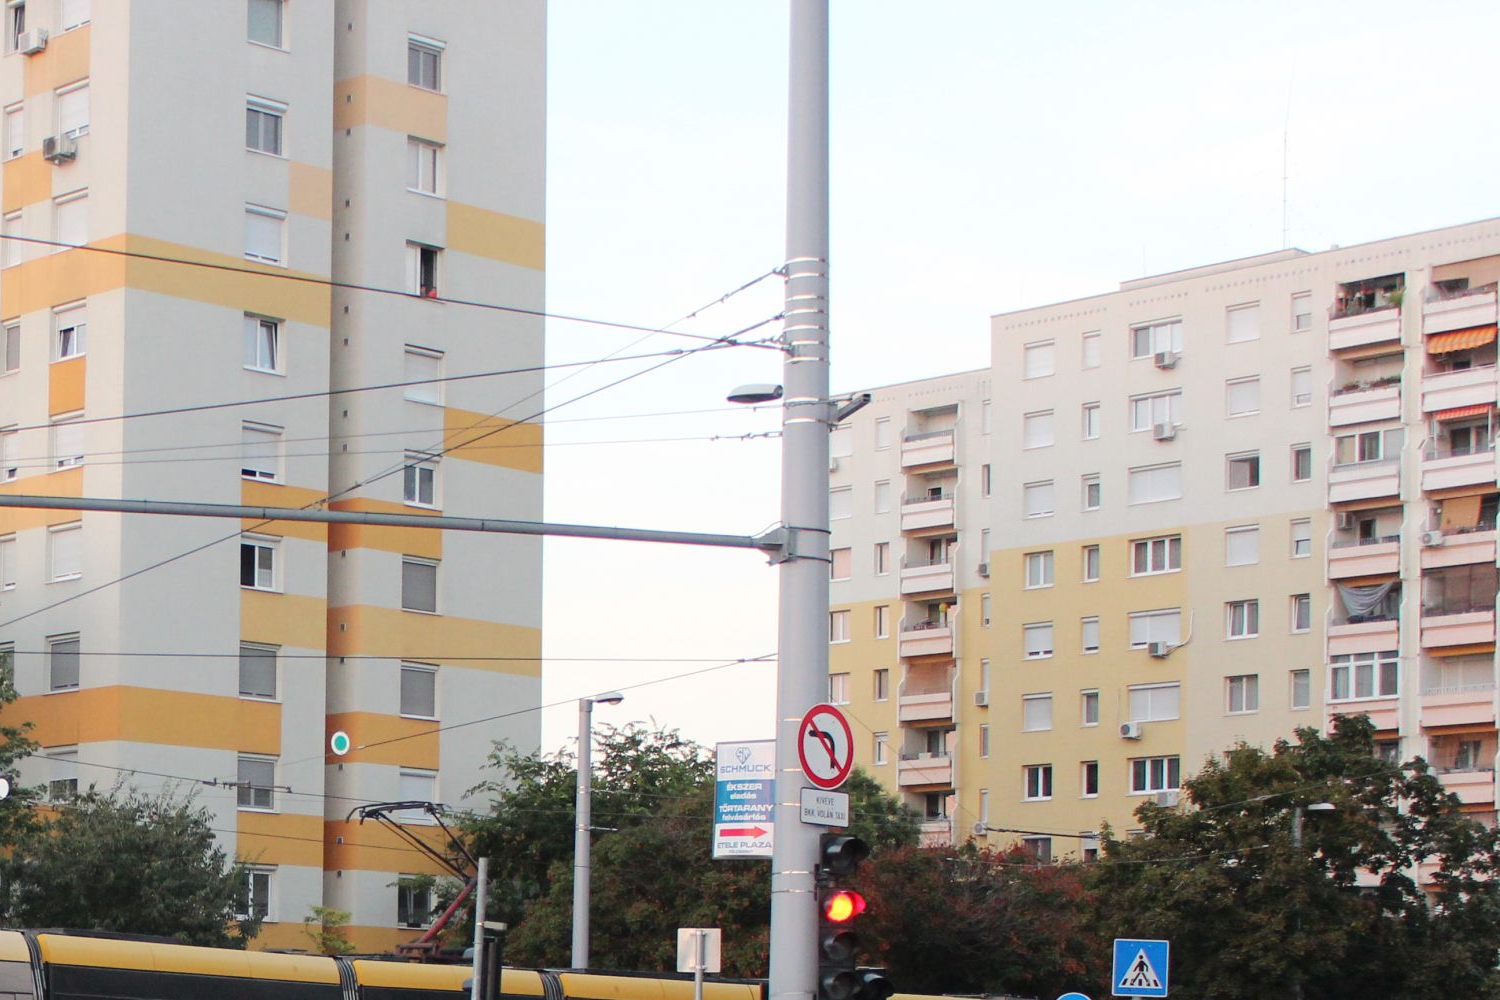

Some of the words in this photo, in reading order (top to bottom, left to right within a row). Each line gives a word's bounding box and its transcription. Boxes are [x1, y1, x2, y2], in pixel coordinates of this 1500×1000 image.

[720, 764, 772, 774] SCHMUCK
[717, 841, 739, 849] ETELE
[740, 841, 773, 849] PLAZA
